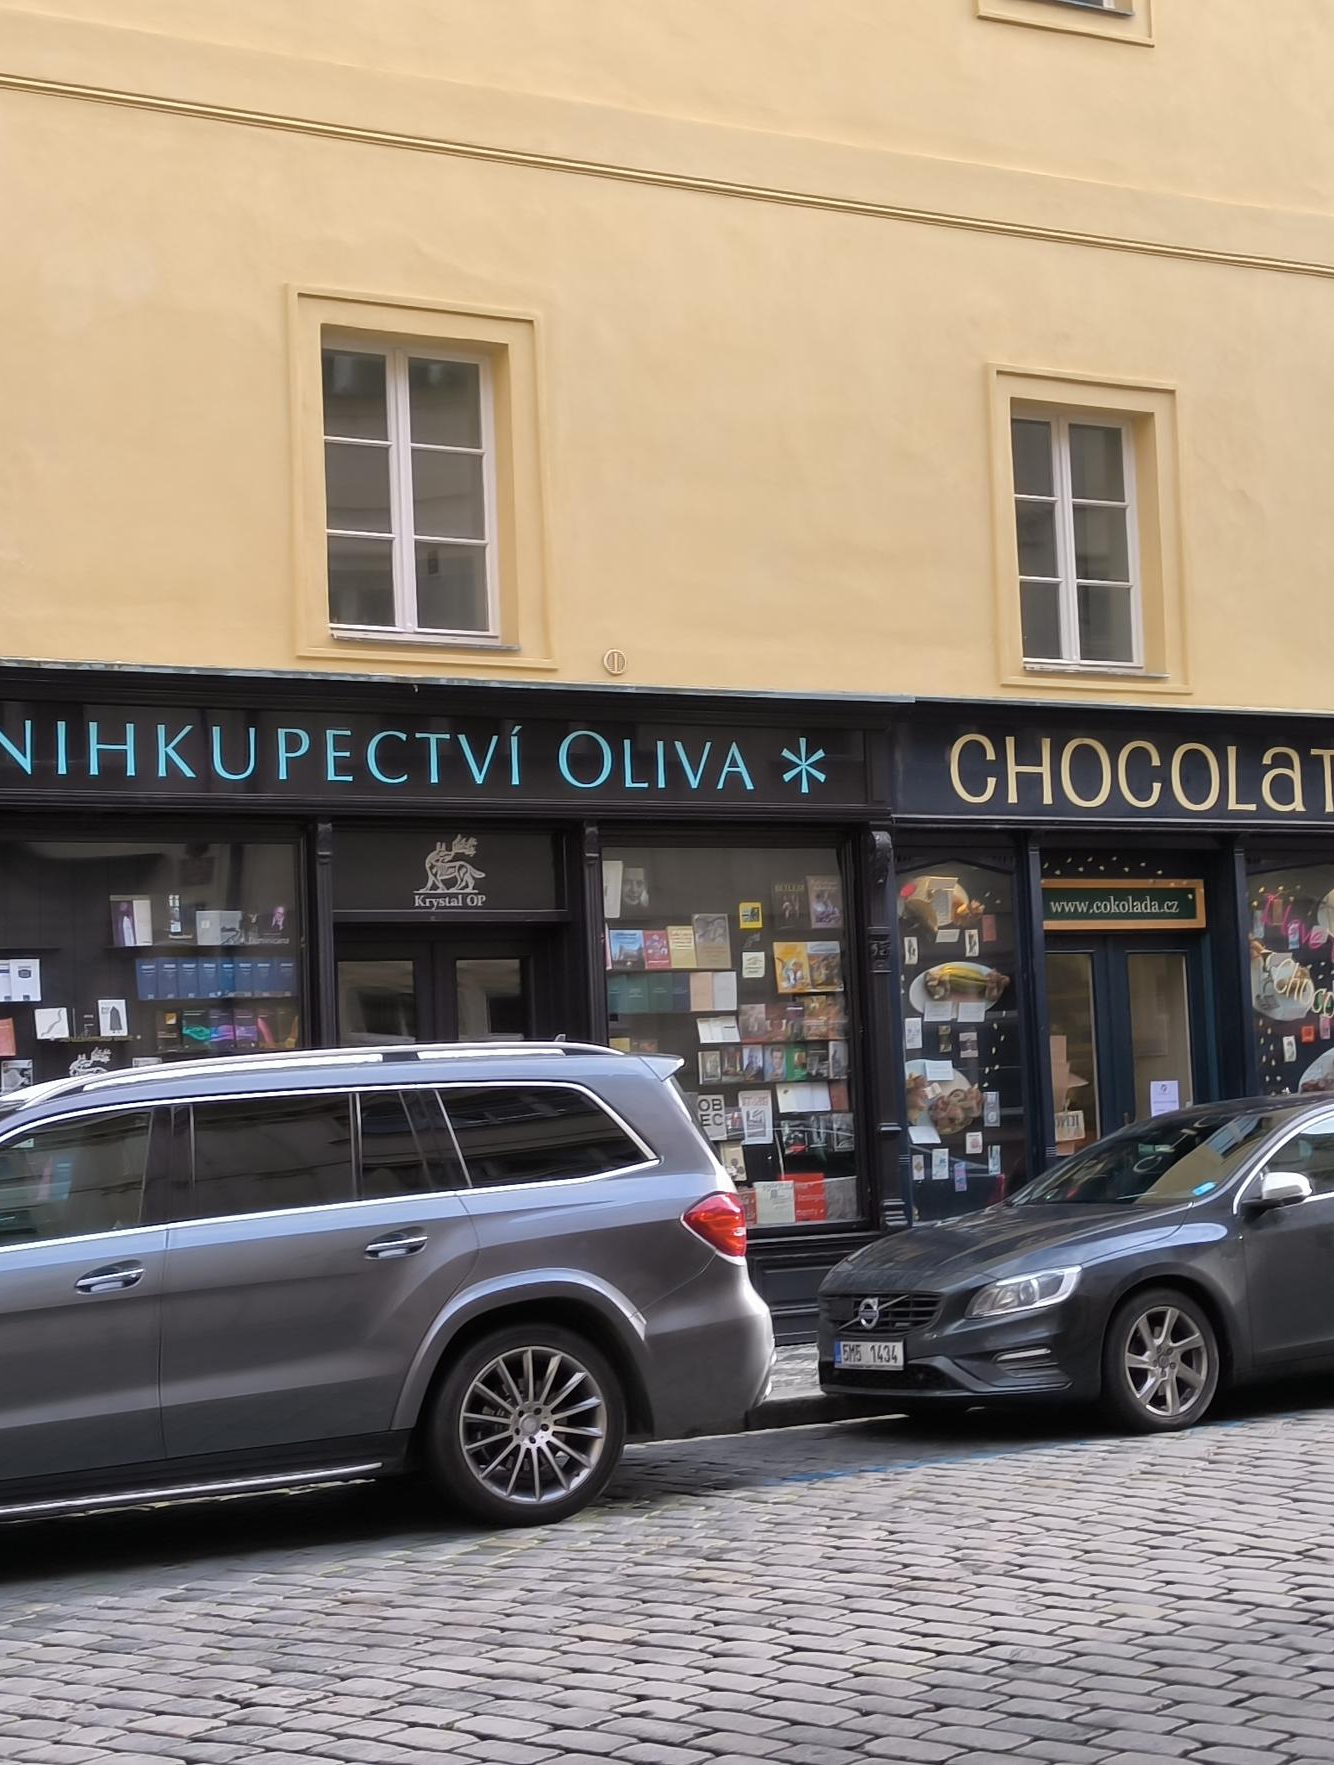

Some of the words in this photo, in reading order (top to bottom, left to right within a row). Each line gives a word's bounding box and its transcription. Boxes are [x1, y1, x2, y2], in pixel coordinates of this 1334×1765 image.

[557, 729, 755, 791] OLIVA
[414, 895, 463, 910] Krystal
[467, 895, 486, 906] OP
[1050, 895, 1180, 914] www.cokolada.cz
[698, 1099, 723, 1112] OB
[700, 1114, 724, 1127] EC
[870, 1345, 898, 1363] 1434
